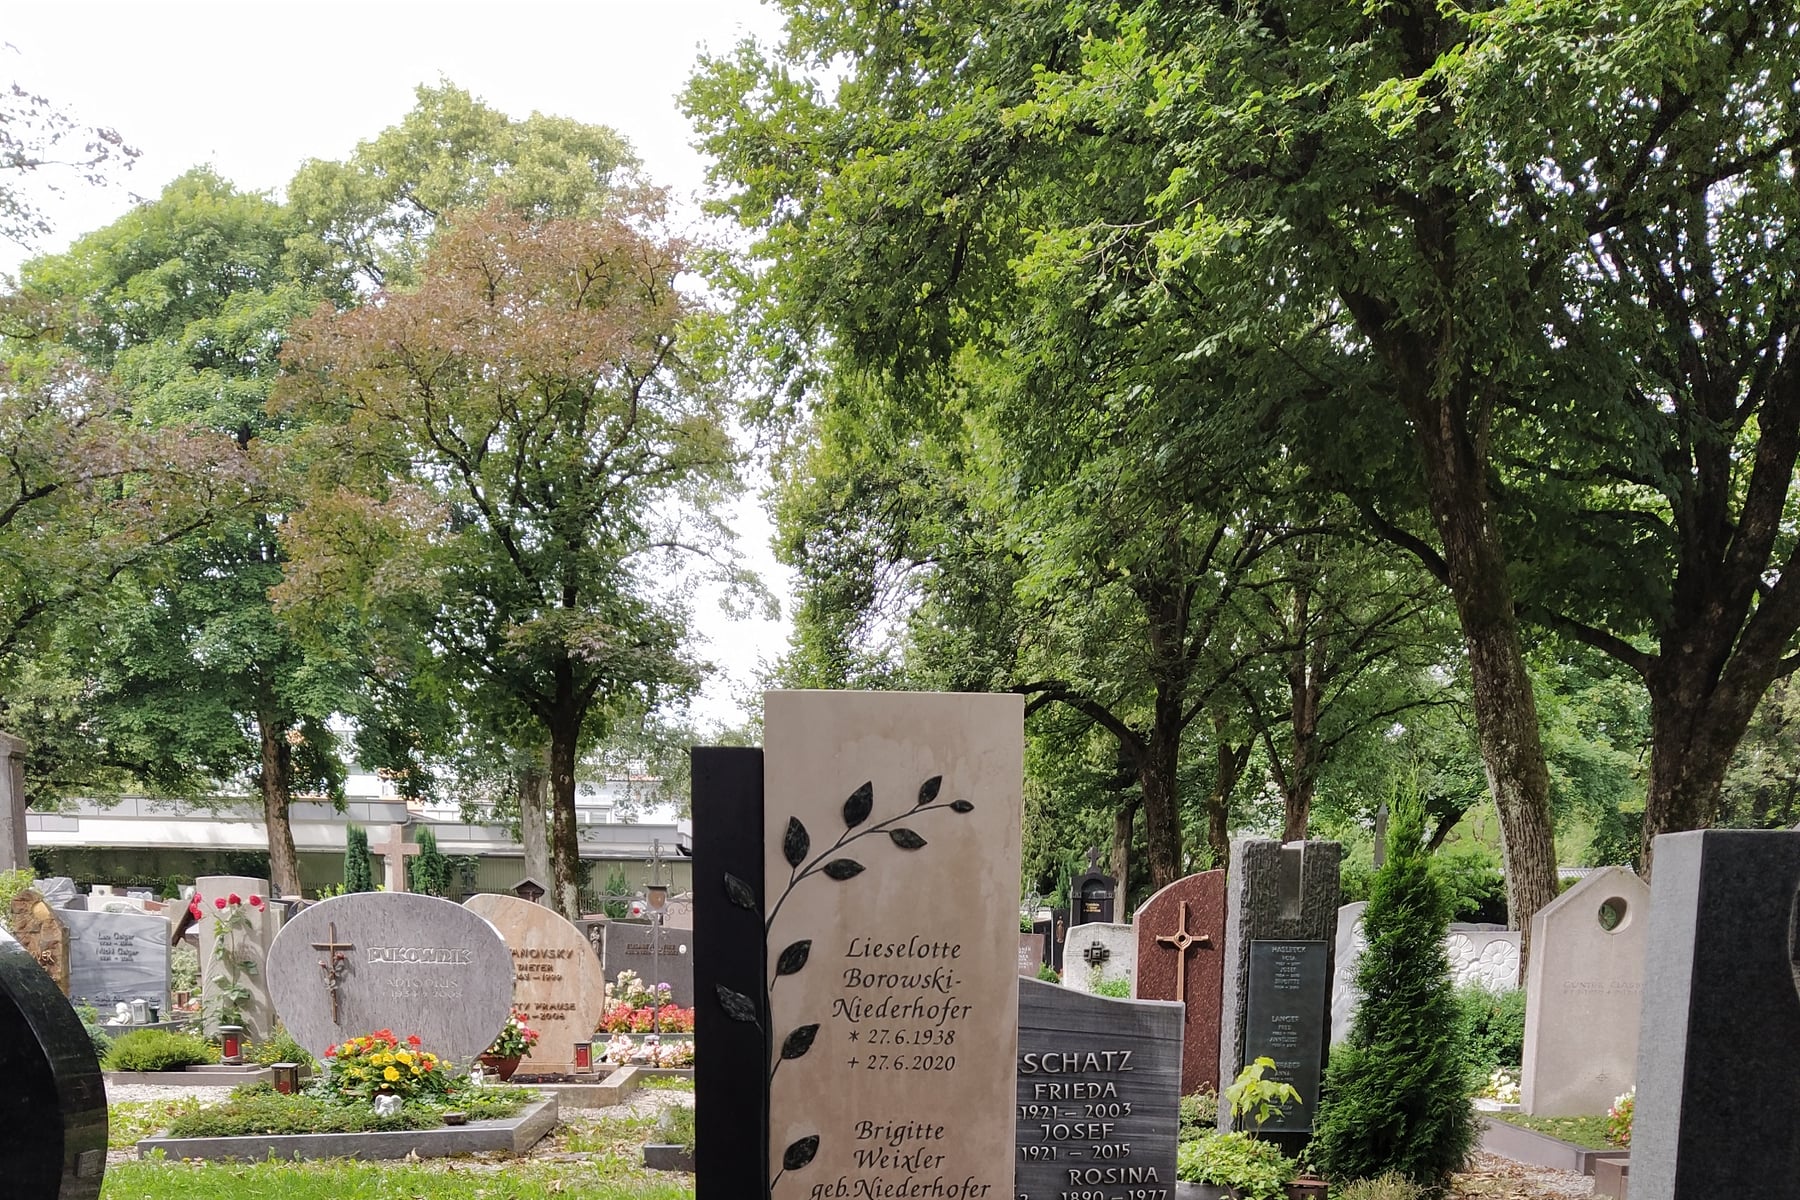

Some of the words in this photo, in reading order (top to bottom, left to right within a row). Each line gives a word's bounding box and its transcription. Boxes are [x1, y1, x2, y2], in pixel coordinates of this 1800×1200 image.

[509, 949, 574, 960] ANOVSKY
[845, 935, 962, 959] Lieselotte
[517, 964, 554, 973] DIETER
[843, 967, 962, 993] Borowski-
[832, 998, 972, 1027] Niederhofer
[868, 1029, 956, 1046] 27.6.1938
[867, 1055, 956, 1072] 27.6.2020
[1020, 1051, 1134, 1074] SCHATZ
[1034, 1082, 1118, 1100] FRIEDA
[1021, 1105, 1057, 1120] 1921
[1084, 1102, 1132, 1119] 2003
[855, 1119, 945, 1146] Brigitte
[1040, 1123, 1114, 1142] JOSEF
[853, 1147, 946, 1174] Weixler
[1021, 1146, 1057, 1161] 1921
[1092, 1143, 1131, 1159] 2015
[1068, 1167, 1159, 1186] ROSINA
